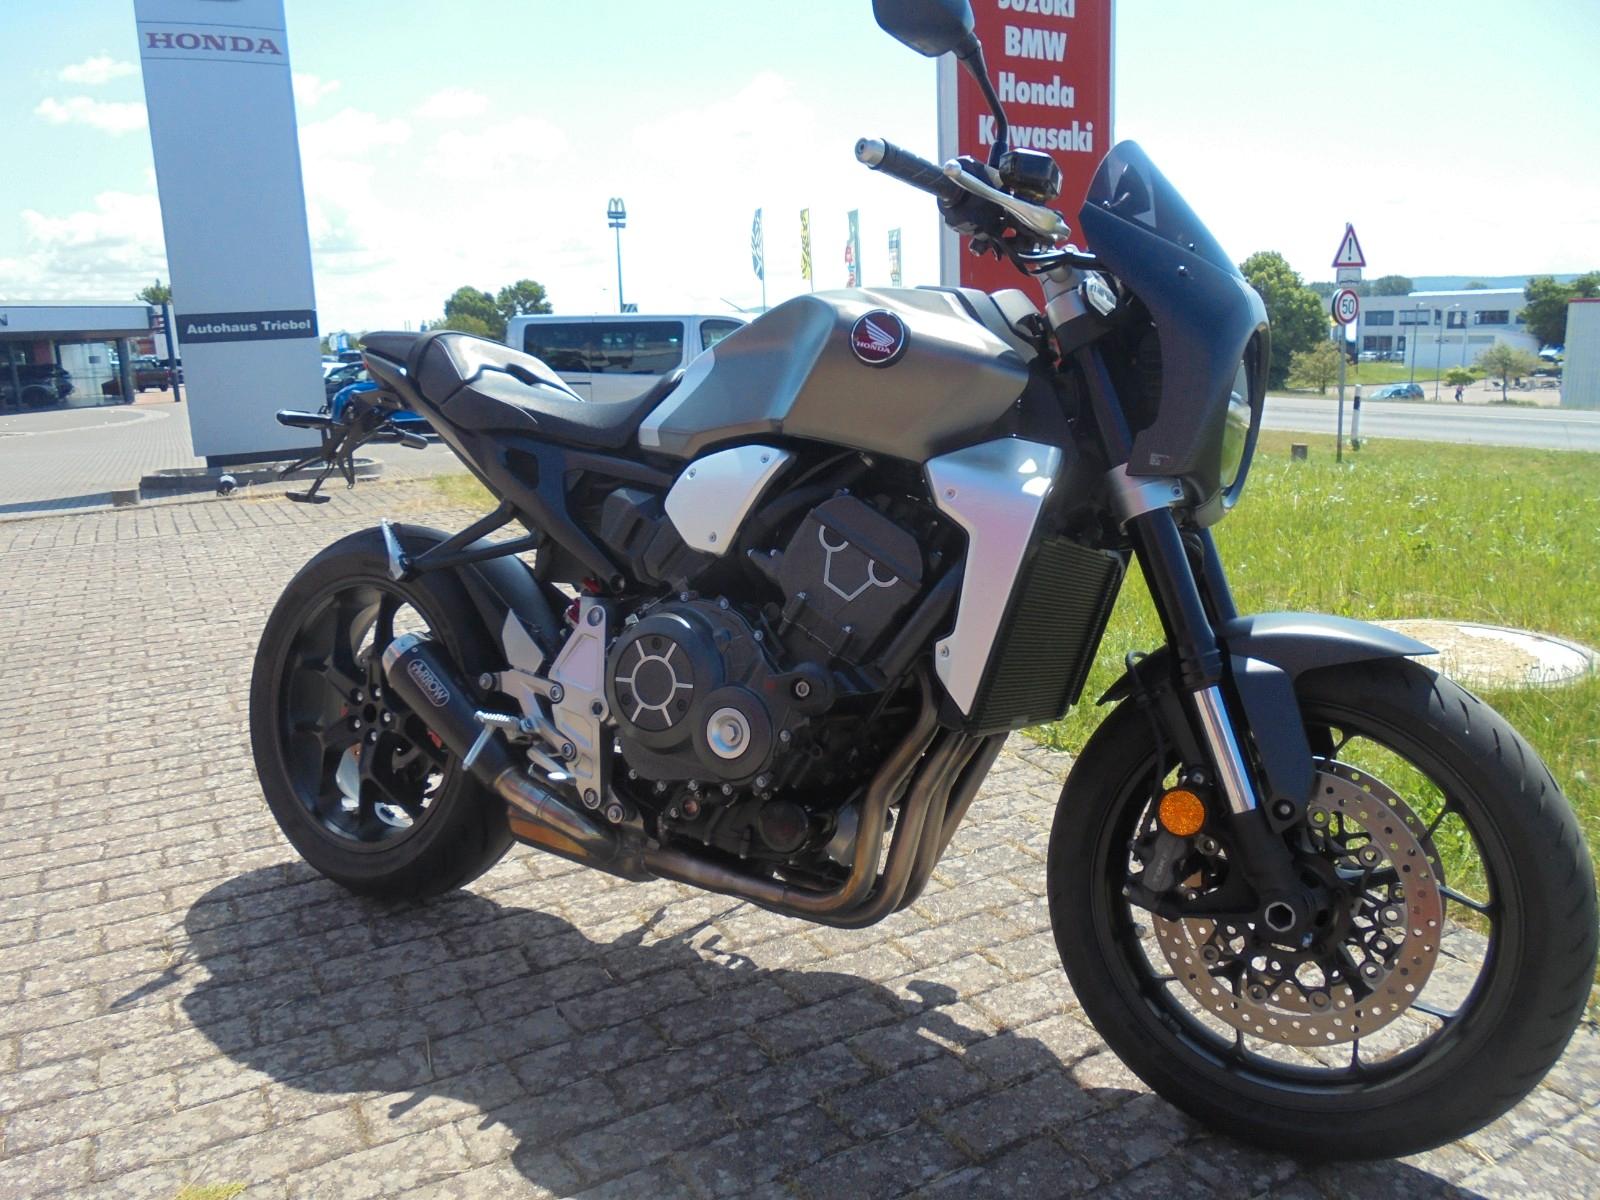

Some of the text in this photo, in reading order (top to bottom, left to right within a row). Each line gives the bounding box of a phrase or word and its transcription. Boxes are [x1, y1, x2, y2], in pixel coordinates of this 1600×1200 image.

[145, 32, 282, 55] HONDA
[1004, 25, 1067, 62] BMW
[998, 71, 1075, 108] Honda
[978, 114, 1093, 152] Kwasaki
[1342, 298, 1355, 314] 50
[186, 319, 312, 335] Autohaus Triebel
[856, 341, 891, 354] HONDA
[410, 662, 449, 700] ARROW
